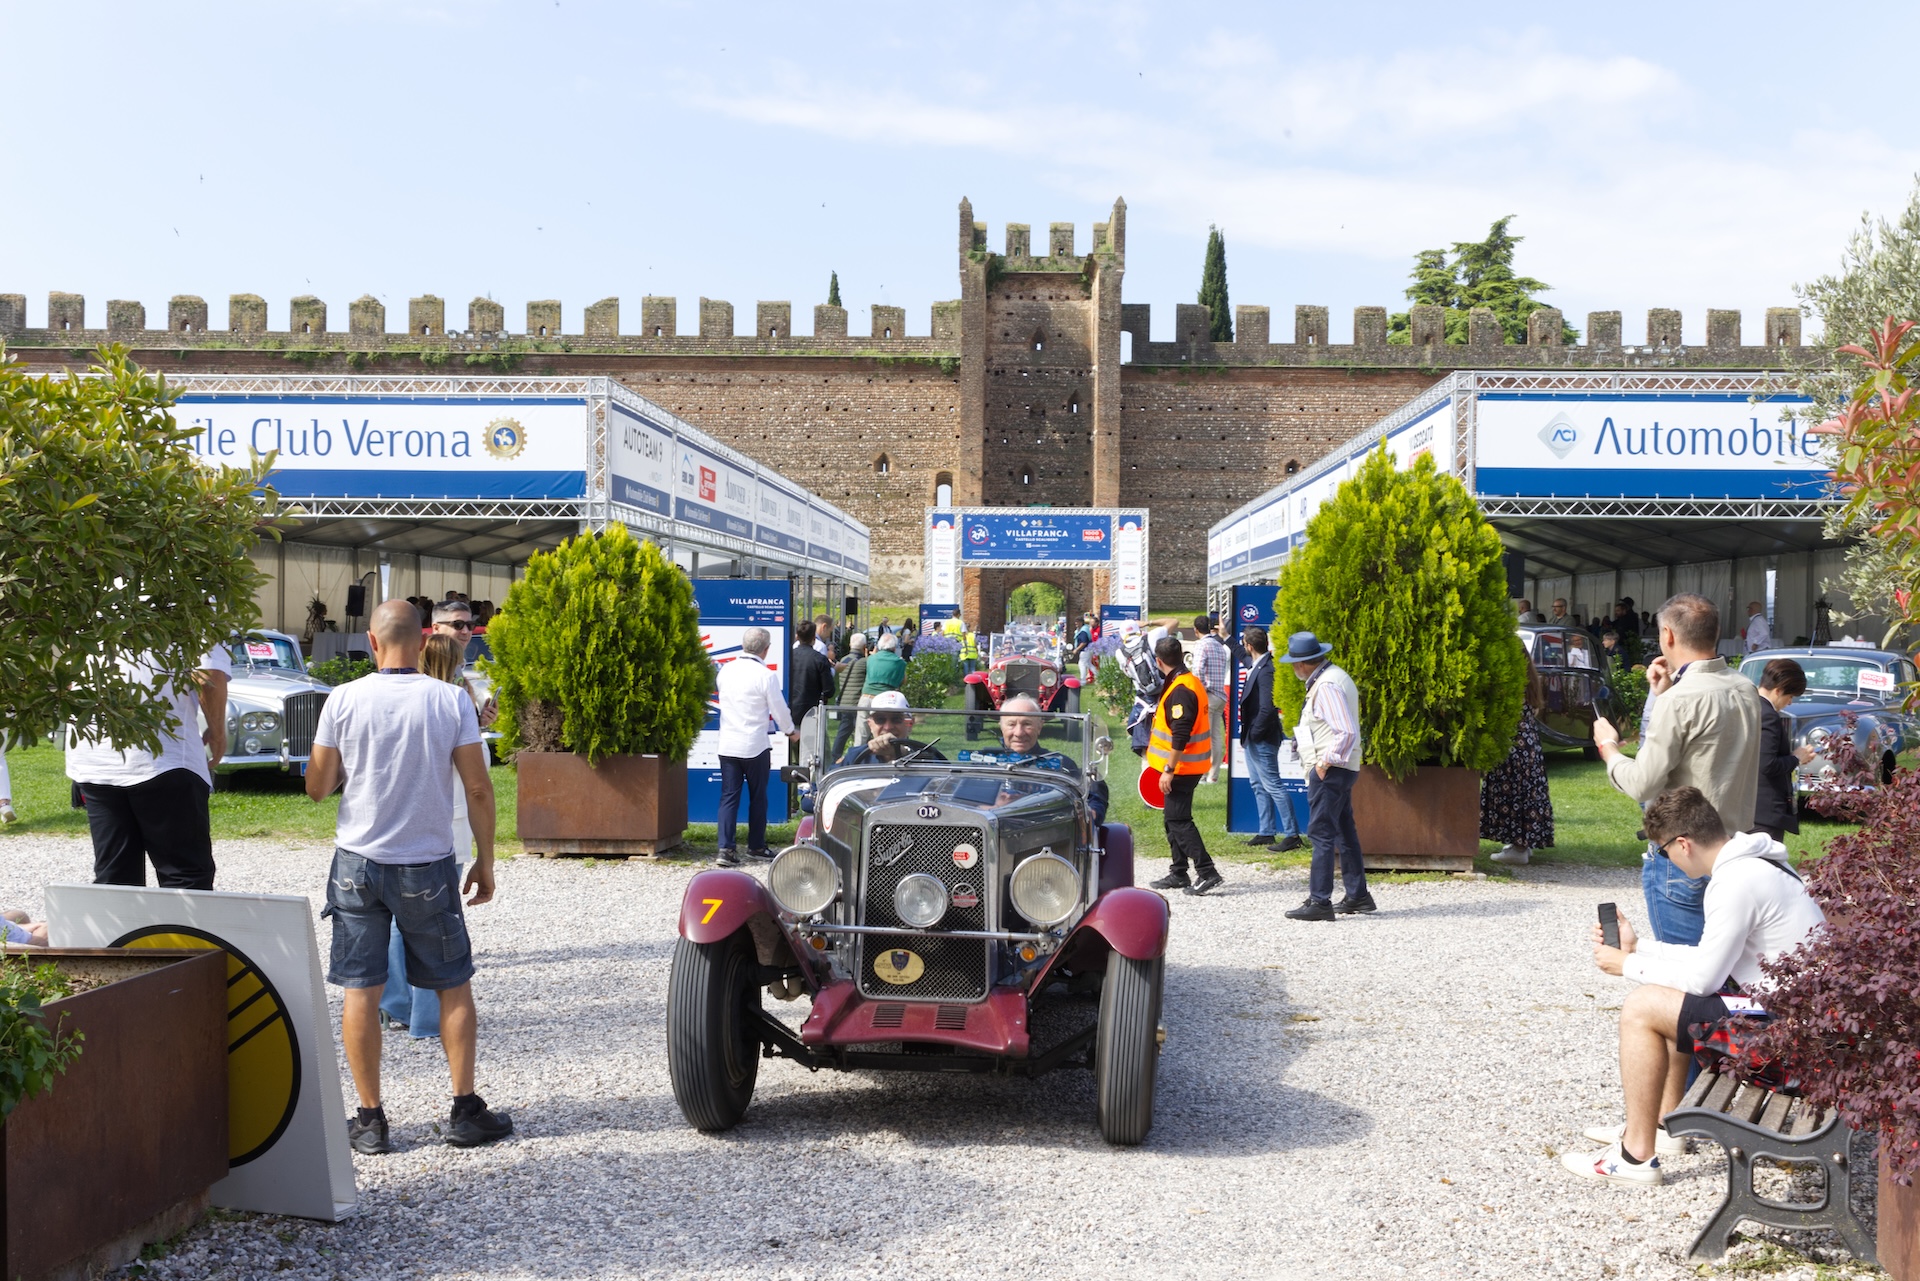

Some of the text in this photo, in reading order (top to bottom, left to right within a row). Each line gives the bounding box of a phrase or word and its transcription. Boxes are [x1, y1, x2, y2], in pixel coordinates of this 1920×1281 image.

[251, 417, 332, 457] Club
[342, 418, 472, 458] Verona
[623, 424, 658, 462] AUTOTEAM
[1551, 428, 1577, 443] ACI
[1593, 416, 1820, 457] Automobile
[1005, 529, 1069, 537] VILLAFRANCA
[1862, 673, 1883, 682] 1000
[918, 807, 939, 818] OM
[874, 832, 914, 866] Superba
[700, 898, 724, 925] 7
